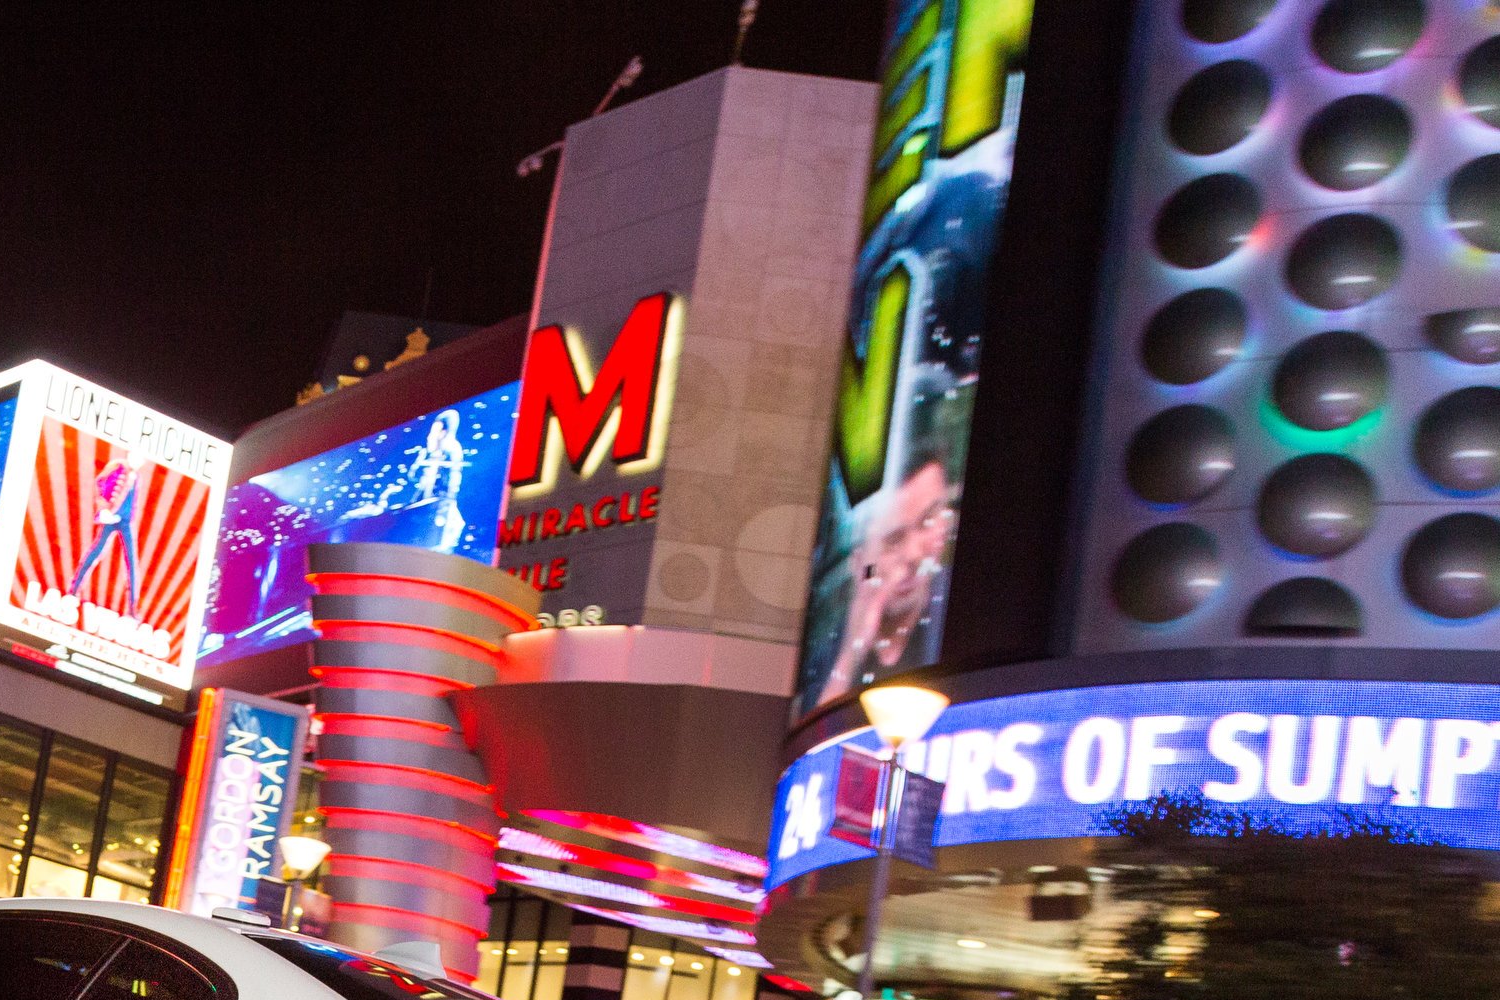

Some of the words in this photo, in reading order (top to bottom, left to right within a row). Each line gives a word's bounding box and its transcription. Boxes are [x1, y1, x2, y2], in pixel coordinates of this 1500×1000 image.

[45, 375, 130, 443] LIONEL
[140, 415, 218, 480] RICHIE
[509, 291, 678, 492] M
[498, 485, 662, 549] MIRACLE
[205, 727, 260, 874] GORDON
[237, 736, 290, 881] RAMSAY
[1062, 714, 1188, 805] OF
[1200, 711, 1500, 810] SUMP
